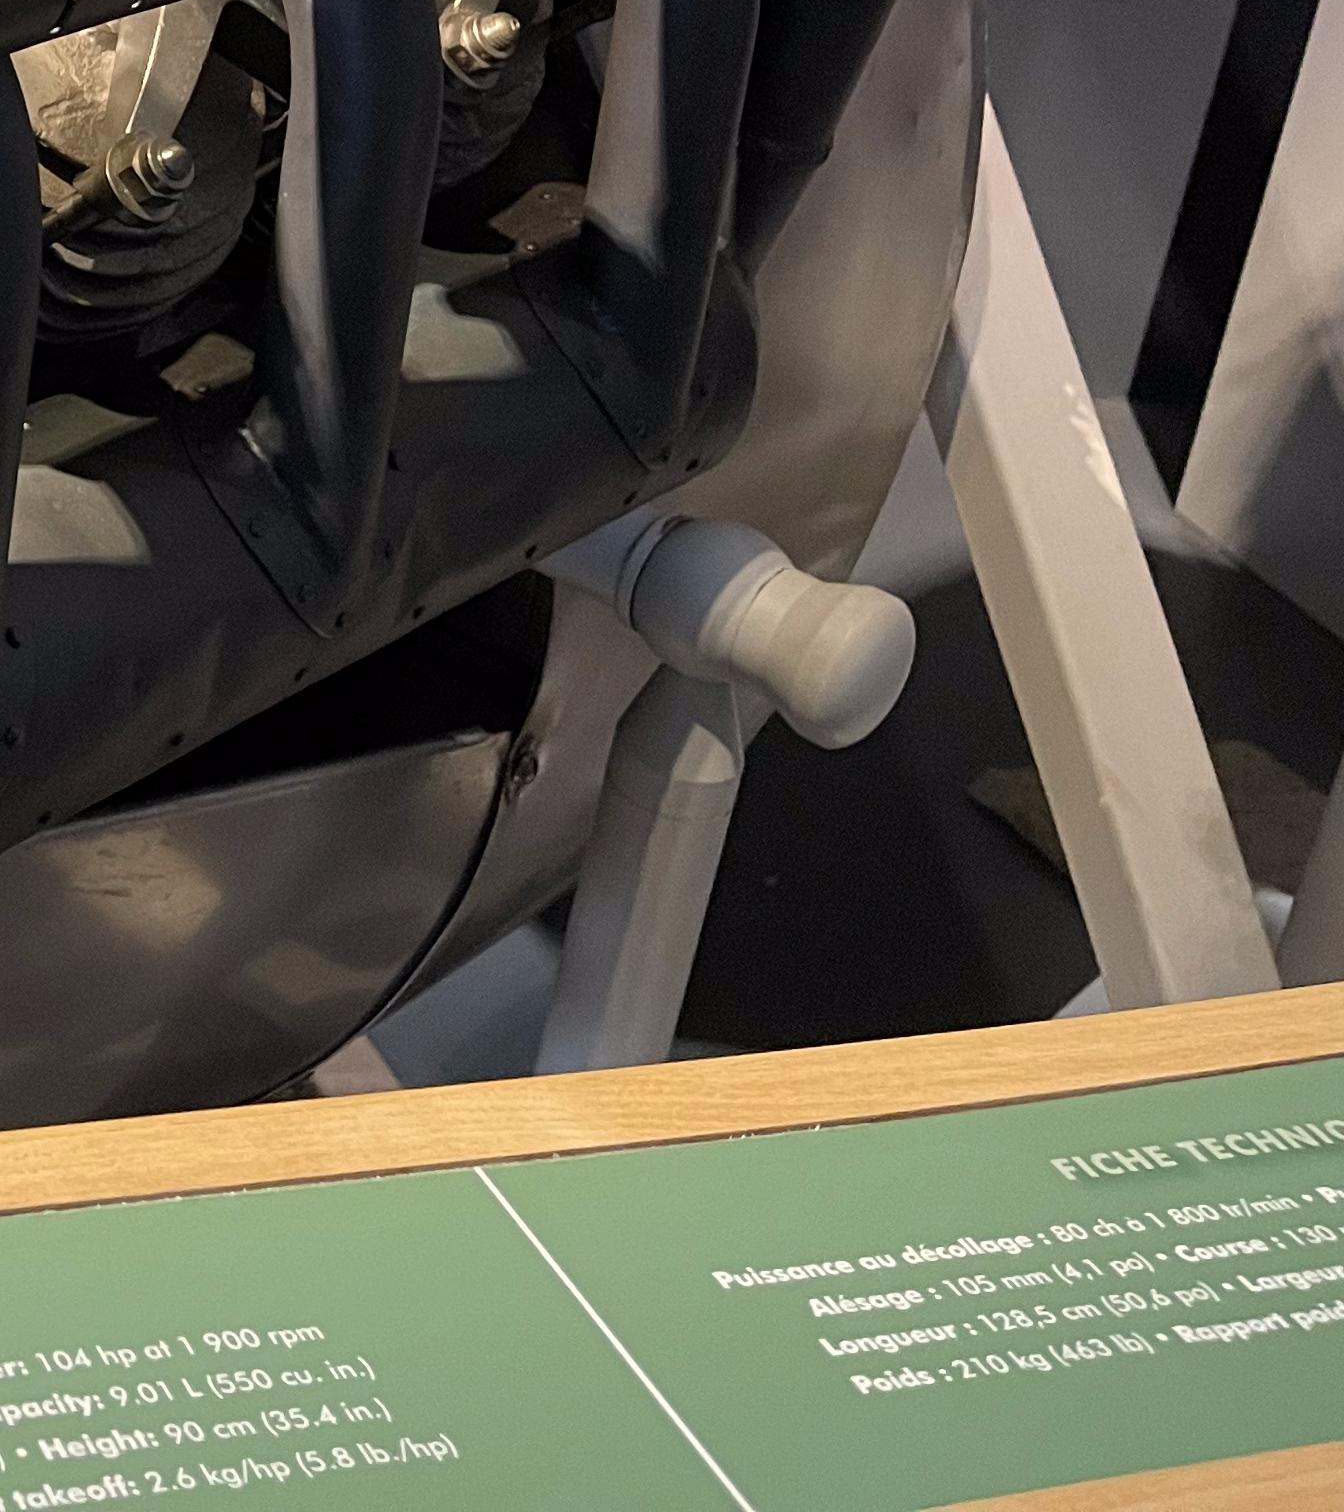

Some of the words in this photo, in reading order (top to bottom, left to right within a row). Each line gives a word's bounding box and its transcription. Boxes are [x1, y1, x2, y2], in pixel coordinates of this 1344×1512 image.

[1050, 1145, 1178, 1181] FICHE
[711, 1260, 856, 1290] Puissance
[857, 1253, 898, 1271] au
[901, 1235, 1035, 1265] décollage
[1049, 1222, 1089, 1243] 80
[1092, 1218, 1126, 1238] ch
[1124, 1216, 1147, 1232] à
[1143, 1212, 1166, 1229] 1
[1166, 1204, 1222, 1226] 800
[1218, 1194, 1301, 1218] tr/min
[808, 1289, 926, 1318] Alésage
[941, 1274, 997, 1297] 105
[1000, 1271, 1054, 1290] mm
[1051, 1258, 1105, 1286] (4,1
[1108, 1251, 1156, 1278] po)
[1174, 1238, 1270, 1263] Course
[1282, 1224, 1338, 1246] 130
[34, 1347, 92, 1373] 104
[95, 1344, 138, 1369] hp
[143, 1339, 173, 1361] at
[176, 1335, 195, 1356] 1
[202, 1328, 261, 1354] 900
[266, 1326, 325, 1350] rpm
[817, 1324, 958, 1358] Longueur
[976, 1304, 1057, 1333] 128,5
[1061, 1304, 1103, 1321] cm
[1100, 1288, 1173, 1318] (50,6
[1173, 1281, 1221, 1308] po)
[849, 1366, 937, 1395] Poids
[951, 1354, 1010, 1379] 210
[1007, 1350, 1053, 1372] kg
[1047, 1338, 1113, 1368] (463
[1108, 1331, 1156, 1355] lb)
[1171, 1312, 1291, 1344] Rapport
[108, 1380, 174, 1408] 9.01
[180, 1377, 205, 1398] L
[205, 1368, 274, 1400] (550
[280, 1369, 324, 1386] cu.
[323, 1355, 376, 1382] in.)
[37, 1429, 160, 1461] Height:
[163, 1420, 205, 1445] 90
[212, 1420, 258, 1439] cm
[260, 1404, 338, 1438] (35.4
[339, 1397, 393, 1423] in.)
[12, 1473, 141, 1511] takeoff:
[143, 1466, 198, 1494] 2.6
[198, 1457, 291, 1489] kg/hp
[295, 1446, 356, 1479] (5.8
[355, 1432, 460, 1465] lb./hp)
